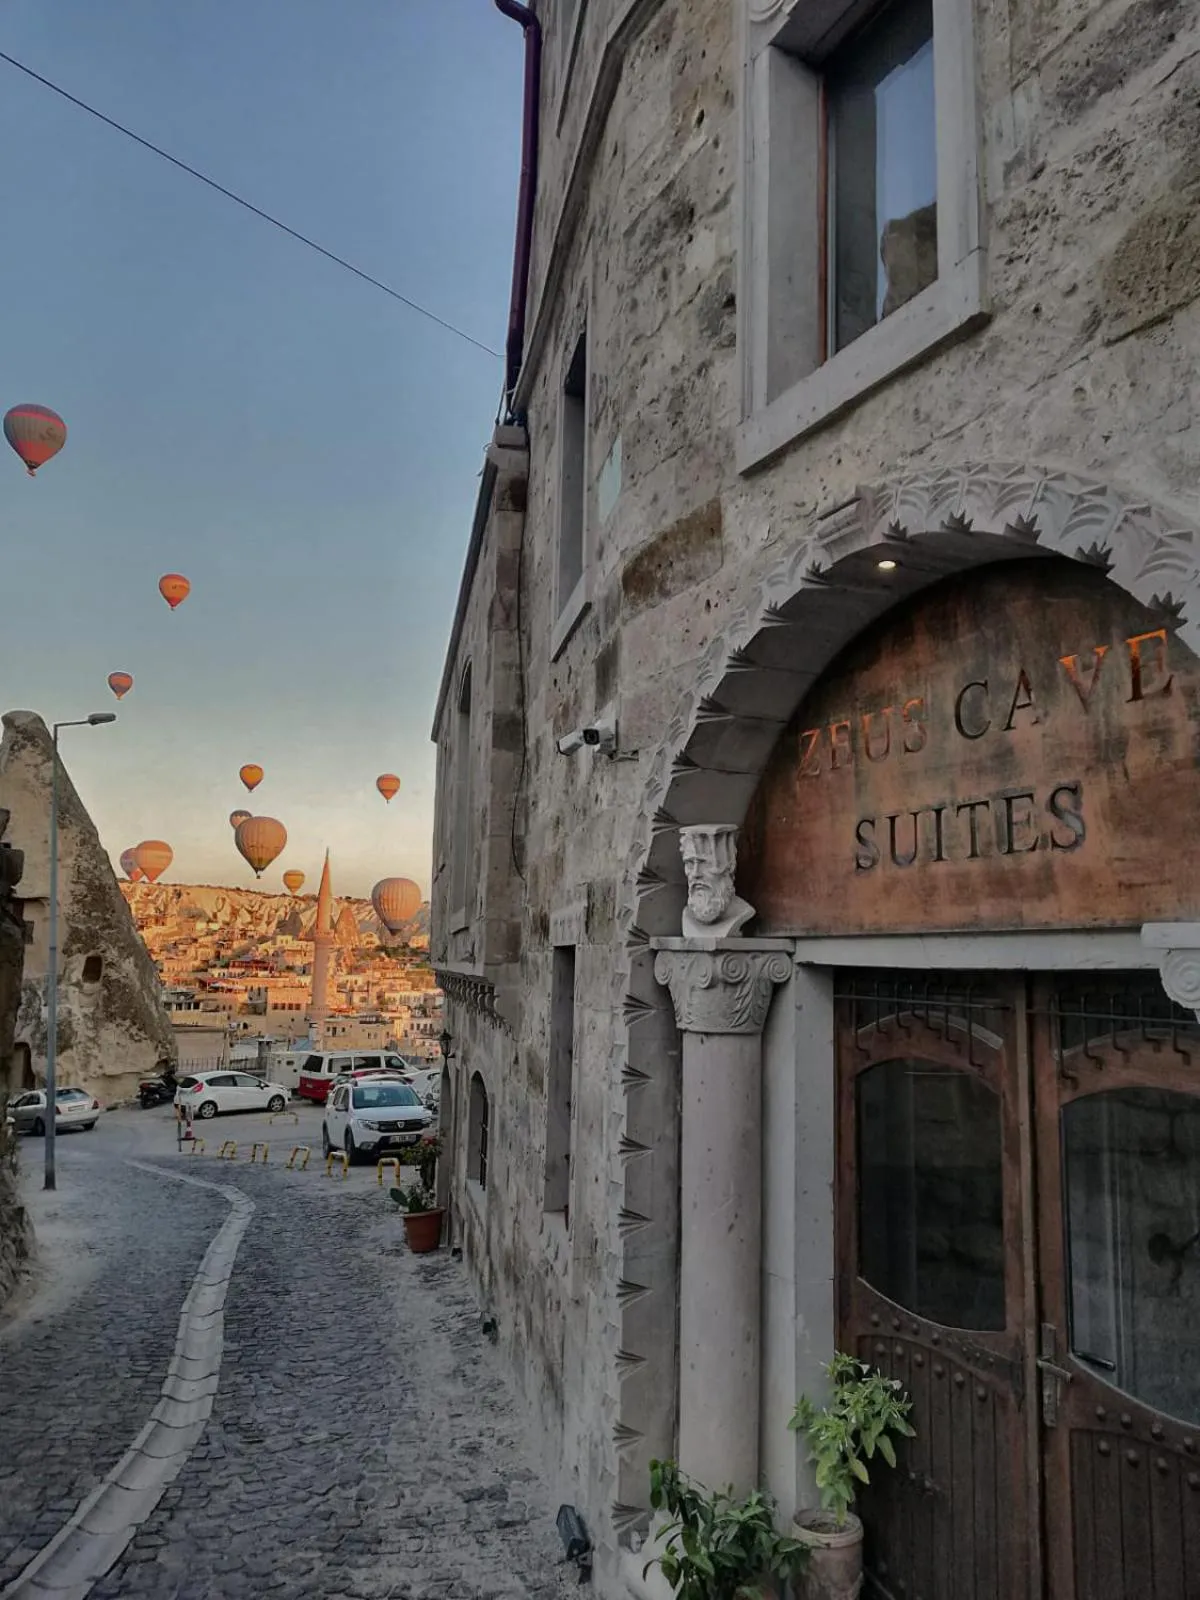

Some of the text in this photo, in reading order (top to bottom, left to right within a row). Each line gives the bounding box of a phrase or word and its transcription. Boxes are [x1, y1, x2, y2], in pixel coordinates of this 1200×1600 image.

[798, 630, 1174, 778] ZEUS CAVE
[855, 784, 1086, 870] SUITES
